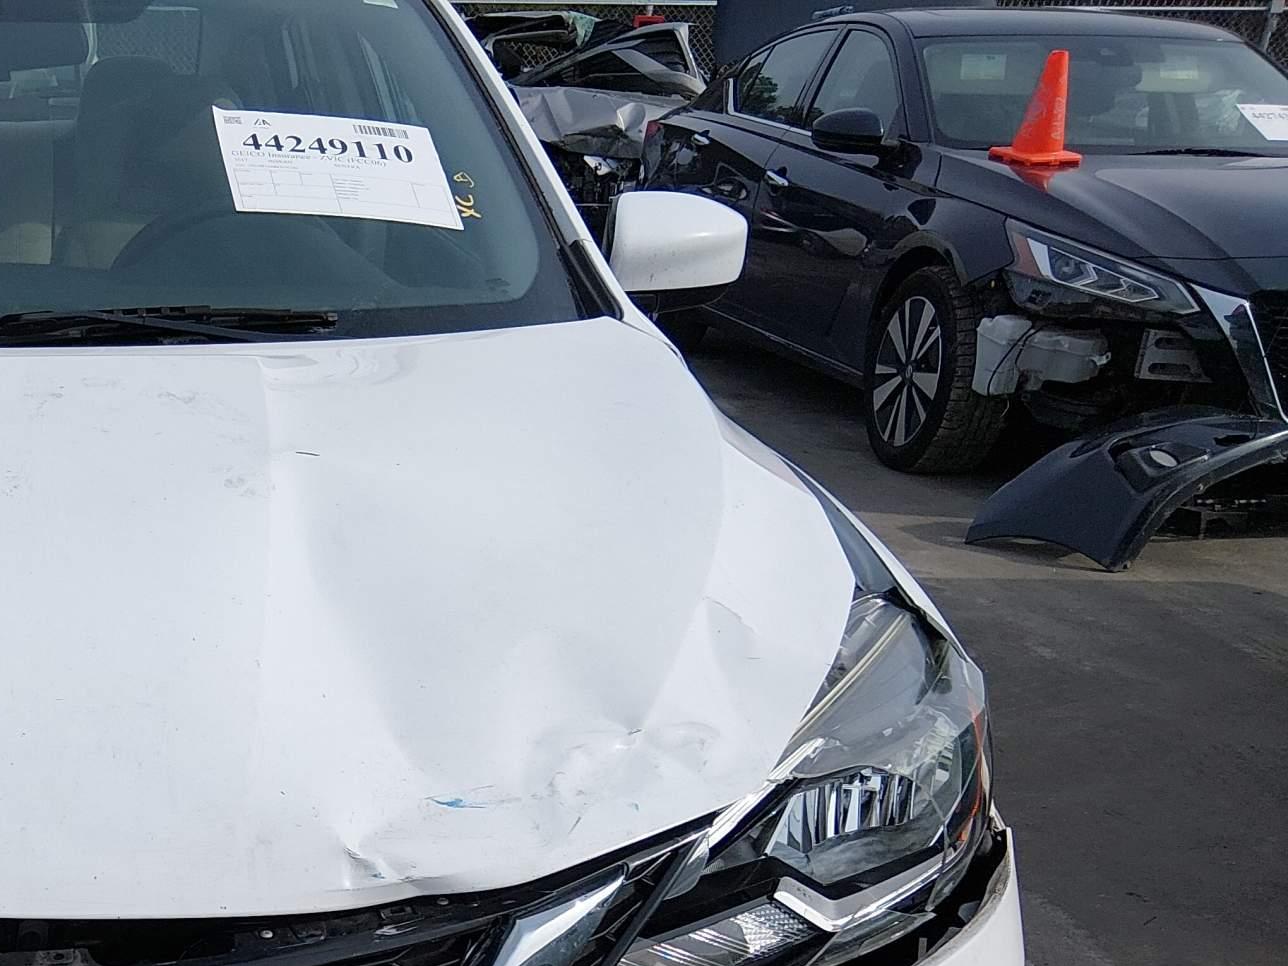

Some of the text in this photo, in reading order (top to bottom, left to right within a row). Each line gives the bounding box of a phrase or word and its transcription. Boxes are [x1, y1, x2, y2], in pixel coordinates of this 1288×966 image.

[231, 150, 265, 158] GEICO
[267, 151, 311, 160] Insurance
[242, 133, 414, 164] 44249110
